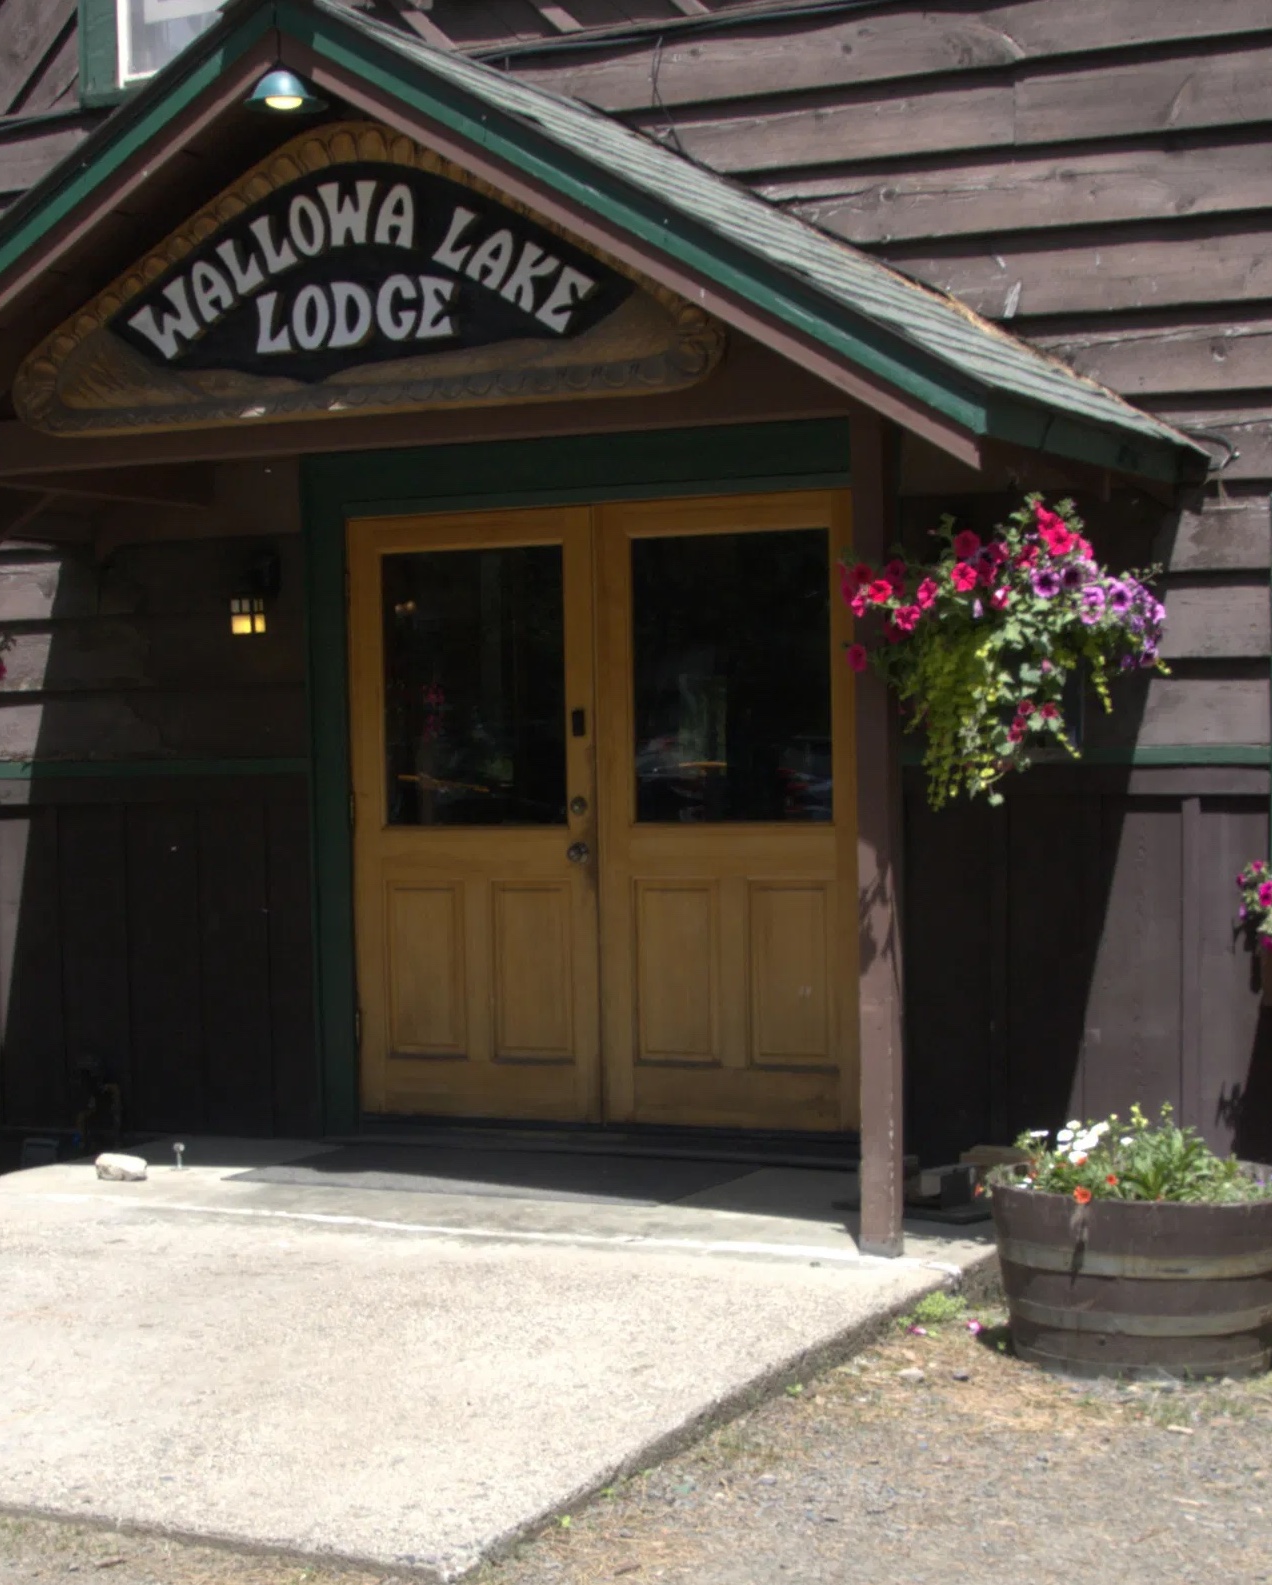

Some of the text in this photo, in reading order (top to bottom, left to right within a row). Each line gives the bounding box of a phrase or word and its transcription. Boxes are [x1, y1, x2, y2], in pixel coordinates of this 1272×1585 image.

[129, 180, 595, 360] WALLOWA LAKE
[256, 275, 459, 354] LODGE
